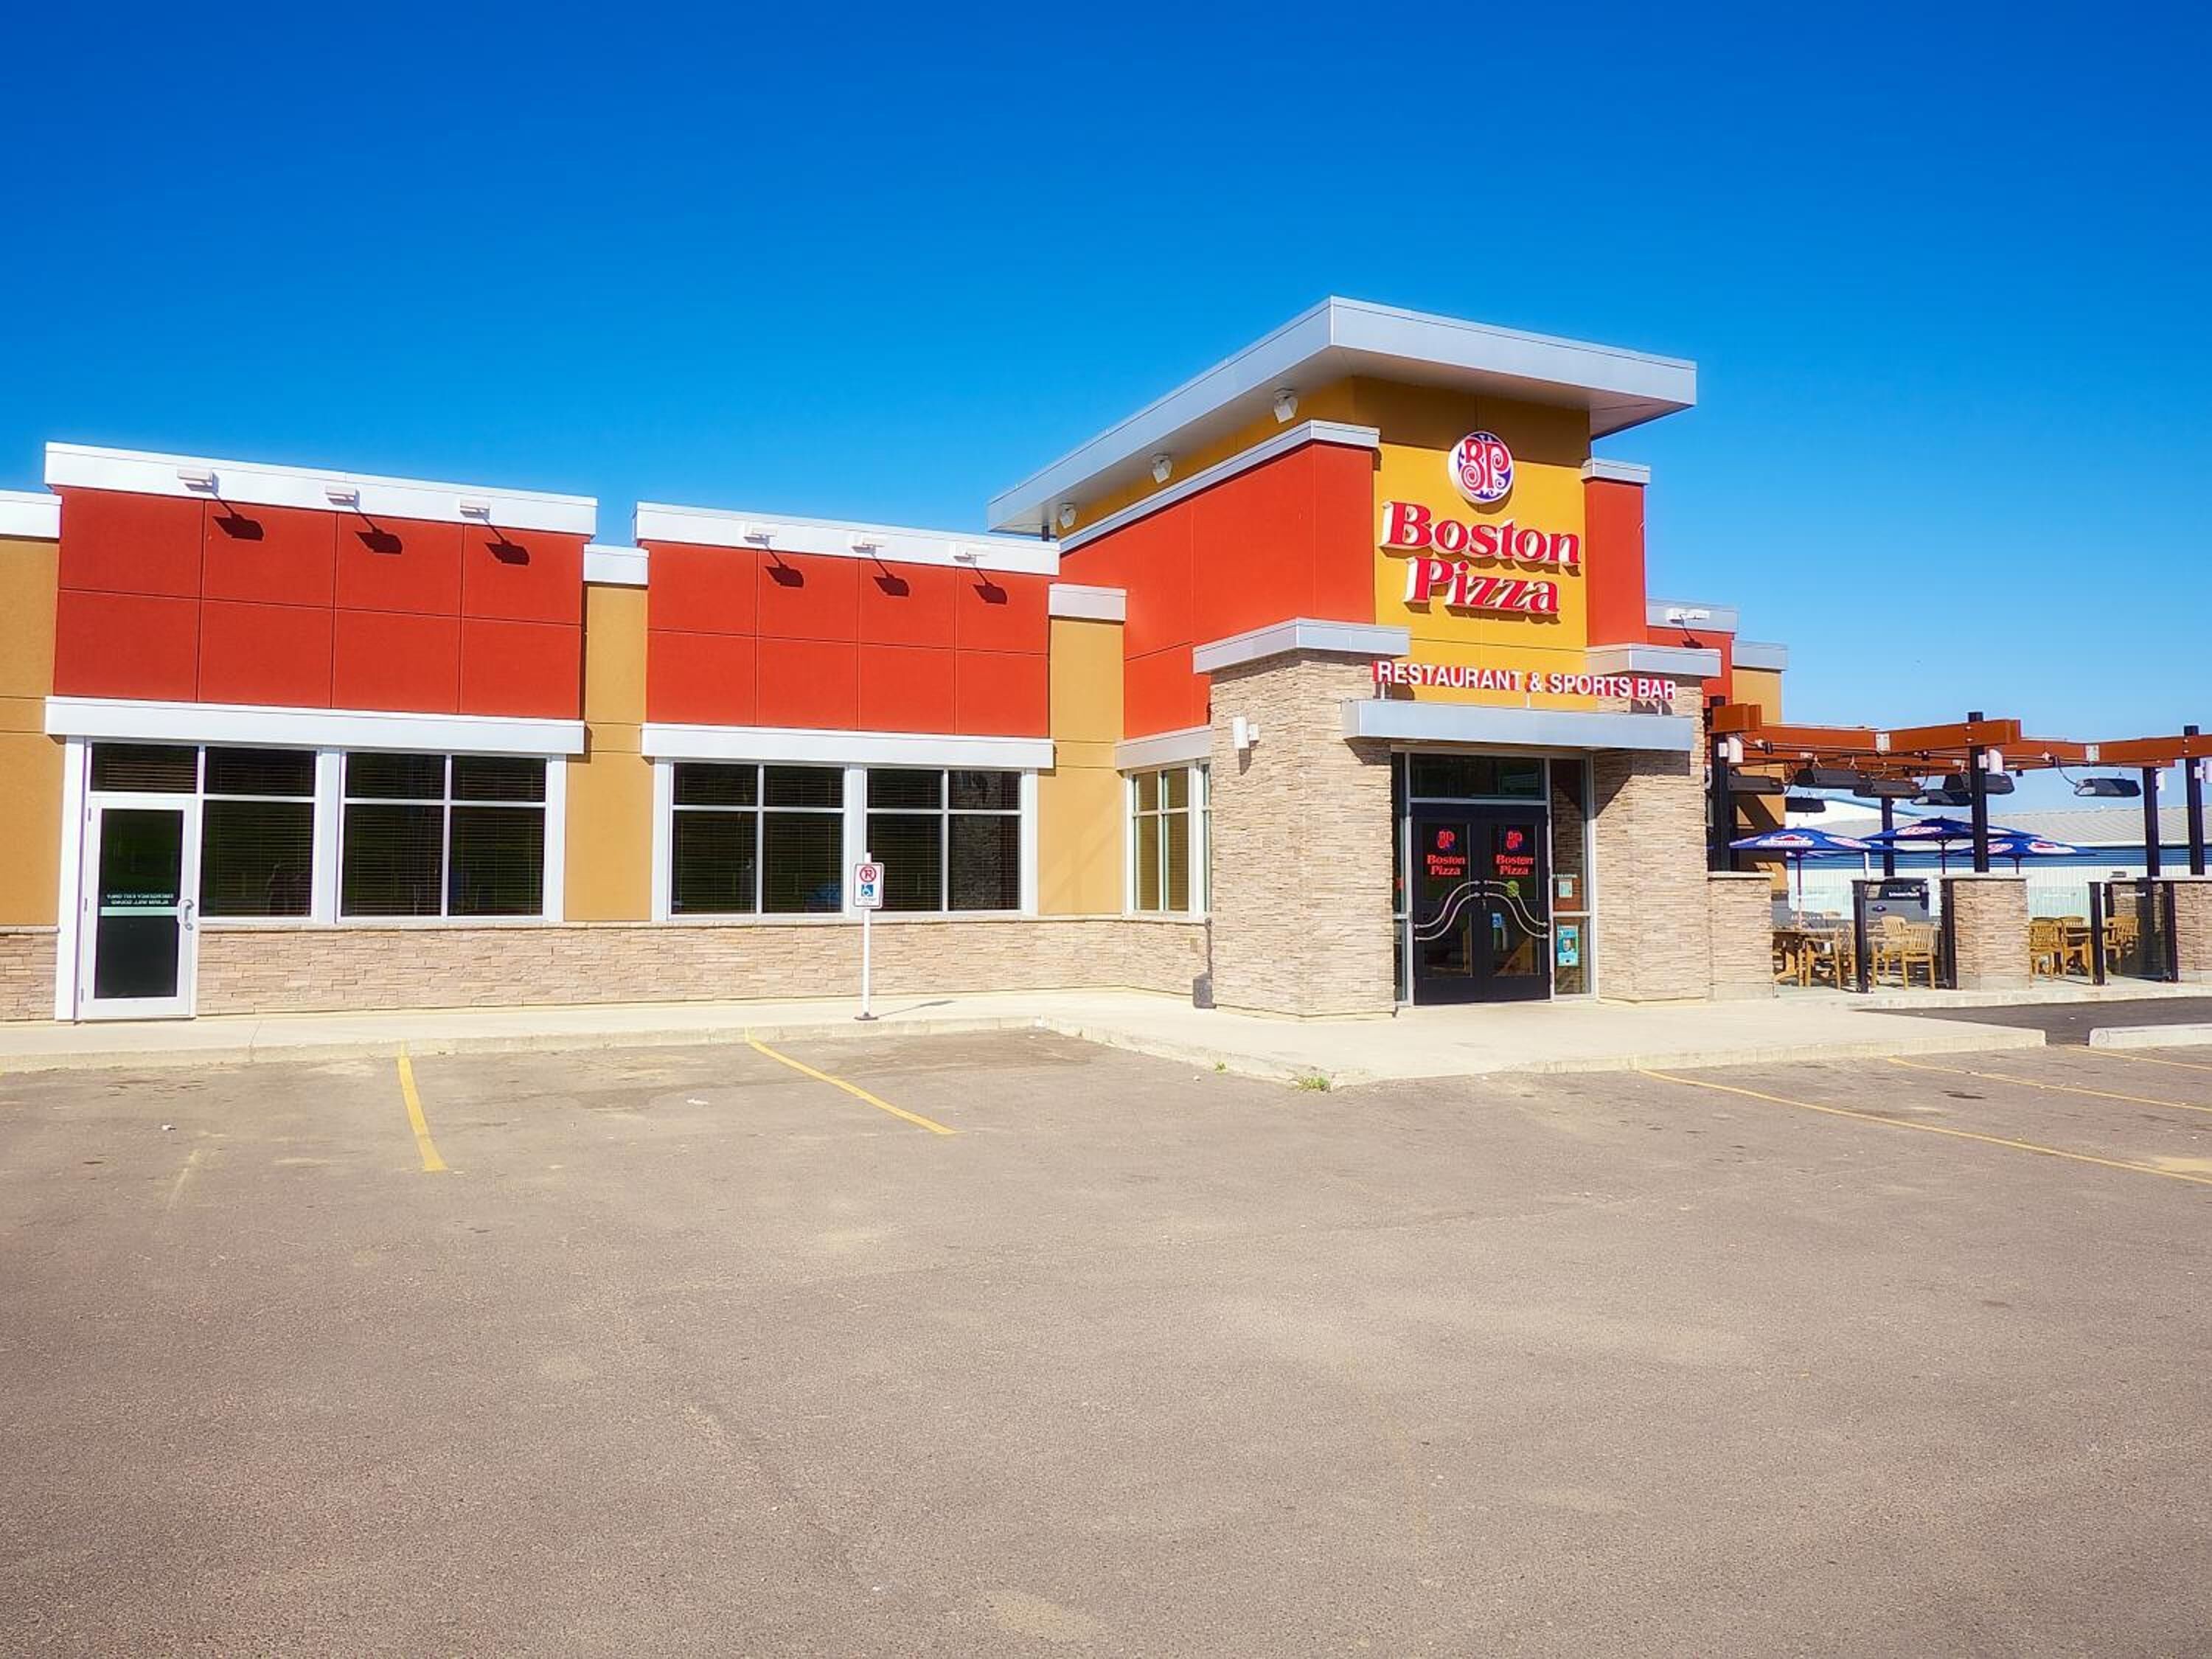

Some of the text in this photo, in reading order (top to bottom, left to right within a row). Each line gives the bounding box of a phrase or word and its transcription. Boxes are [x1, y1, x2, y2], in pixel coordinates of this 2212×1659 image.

[1460, 437, 1509, 492] BP
[1382, 501, 1581, 563] Boston
[1405, 557, 1559, 613] Pizza
[1376, 661, 1676, 700] RESTAURANT & SPORTS BAR
[1427, 855, 1466, 865] Boston
[1430, 866, 1461, 875] Pizza
[1496, 855, 1534, 865] Boston
[1500, 866, 1528, 875] Pizza
